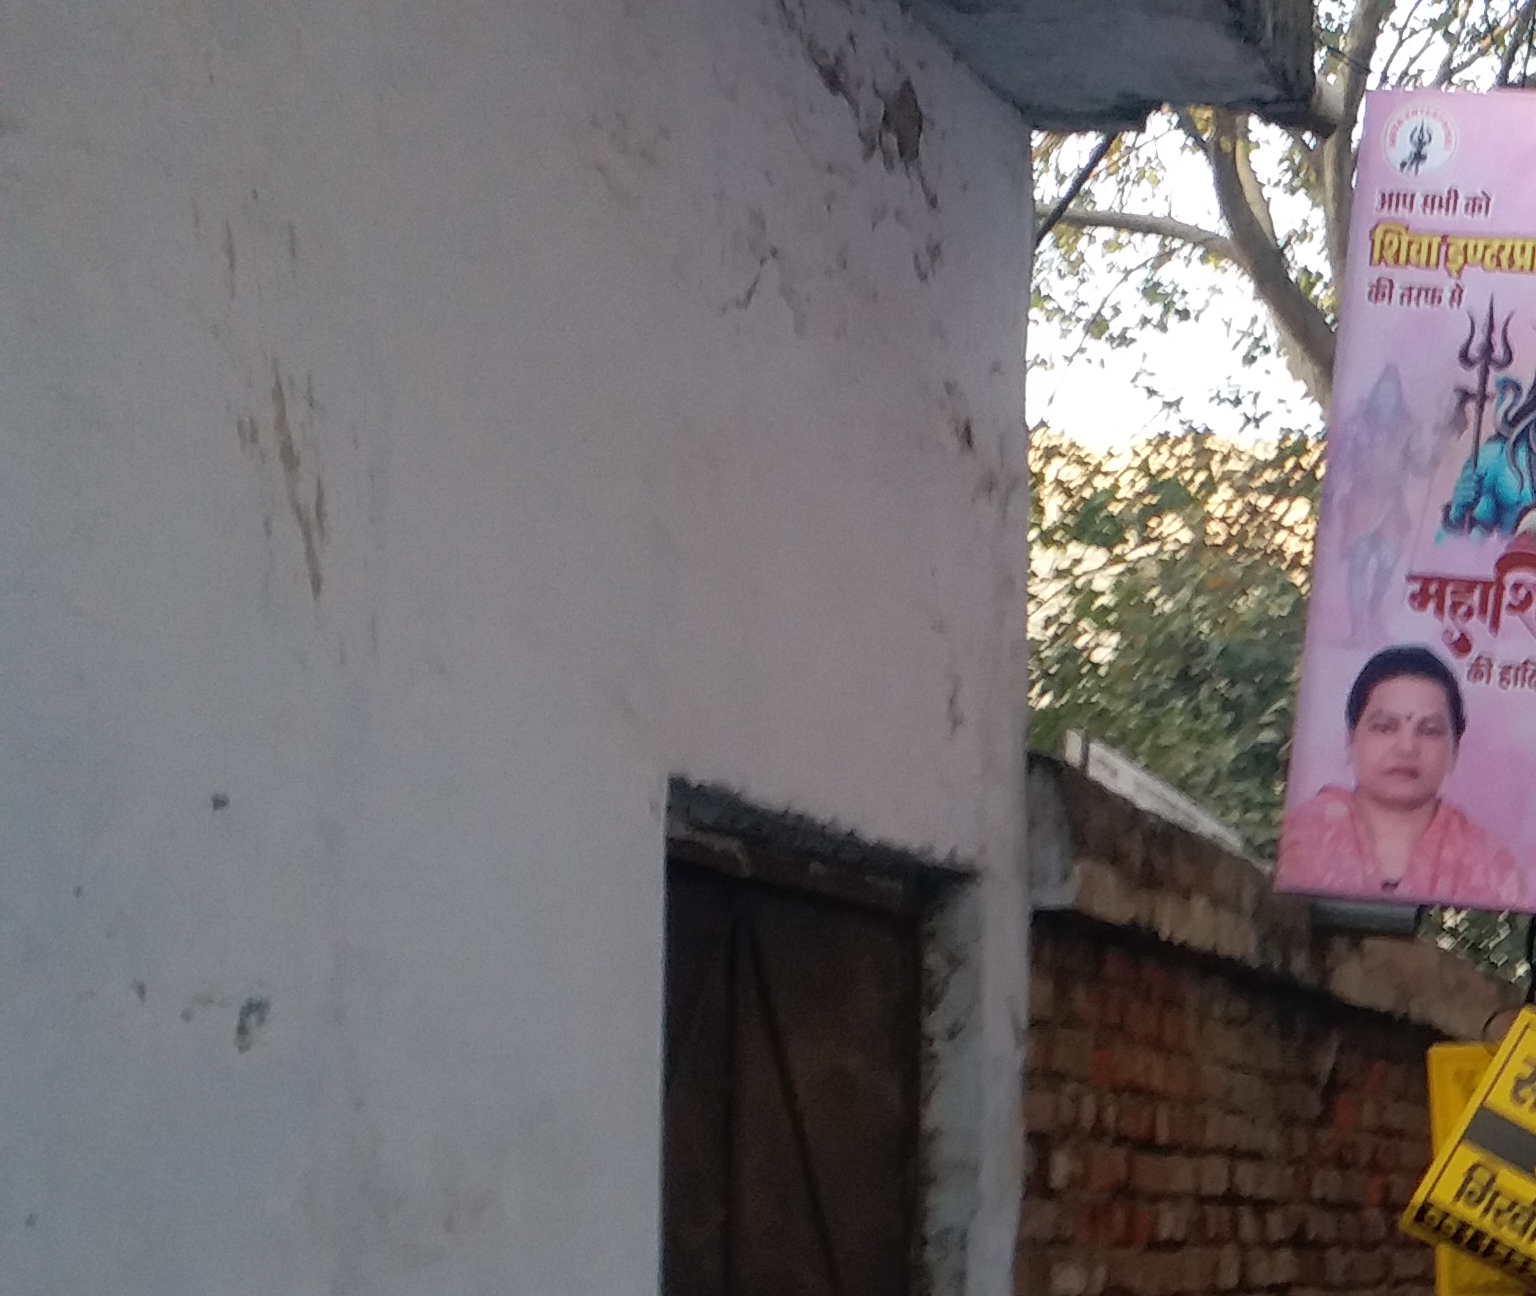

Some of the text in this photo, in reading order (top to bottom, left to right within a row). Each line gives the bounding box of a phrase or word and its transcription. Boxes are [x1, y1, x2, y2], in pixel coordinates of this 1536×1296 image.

[1375, 187, 1492, 218] आप सभी को
[1370, 221, 1441, 268] शिवा
[1368, 278, 1464, 309] की तरफ से
[1467, 655, 1494, 685] की
